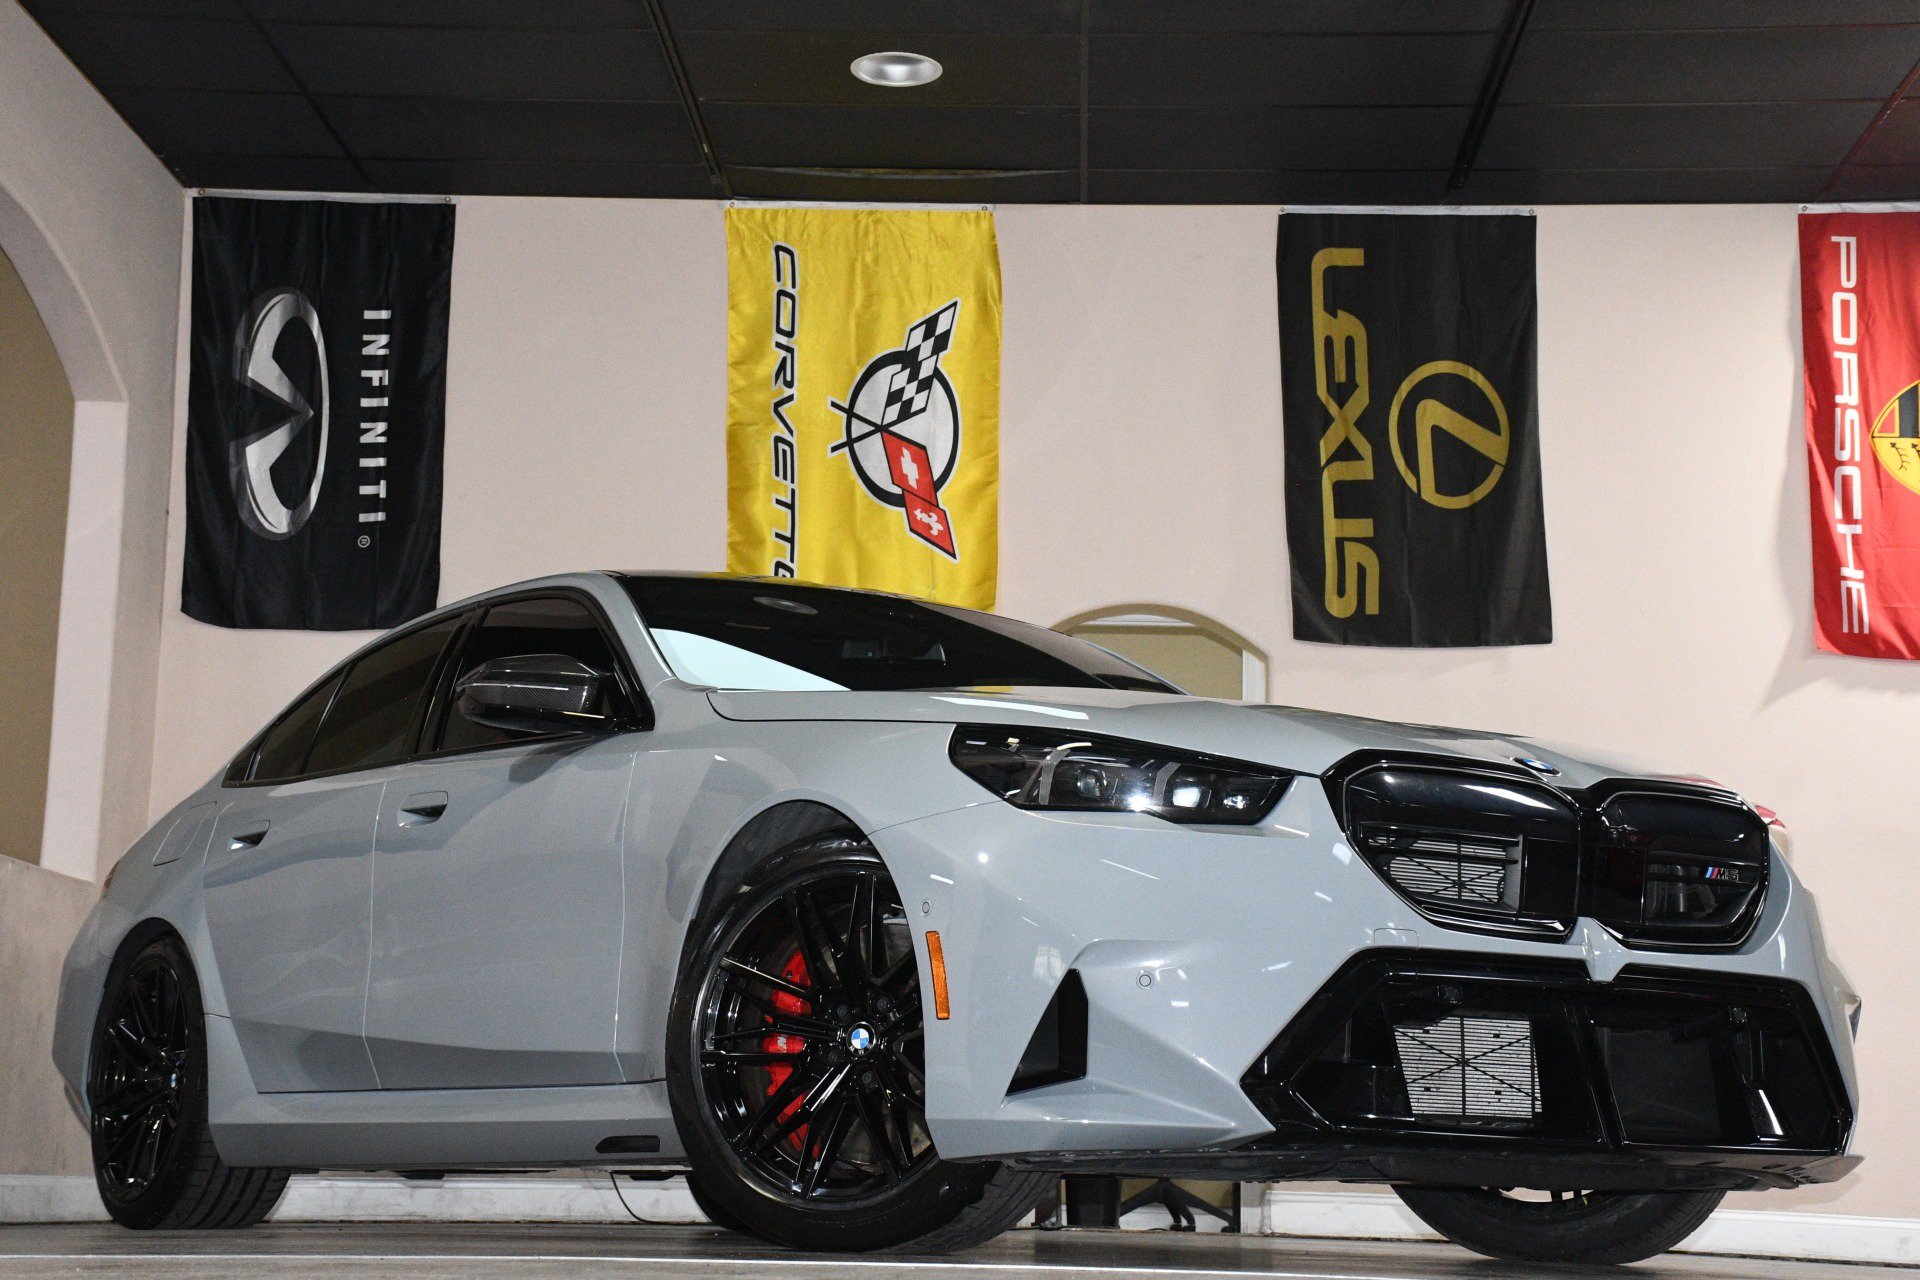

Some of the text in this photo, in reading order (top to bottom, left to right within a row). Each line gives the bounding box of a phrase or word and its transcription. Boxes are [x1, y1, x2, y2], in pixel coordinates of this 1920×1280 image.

[358, 309, 392, 523] INFINITI
[1311, 247, 1380, 619] LEXUS
[1831, 235, 1870, 635] PORSCHE
